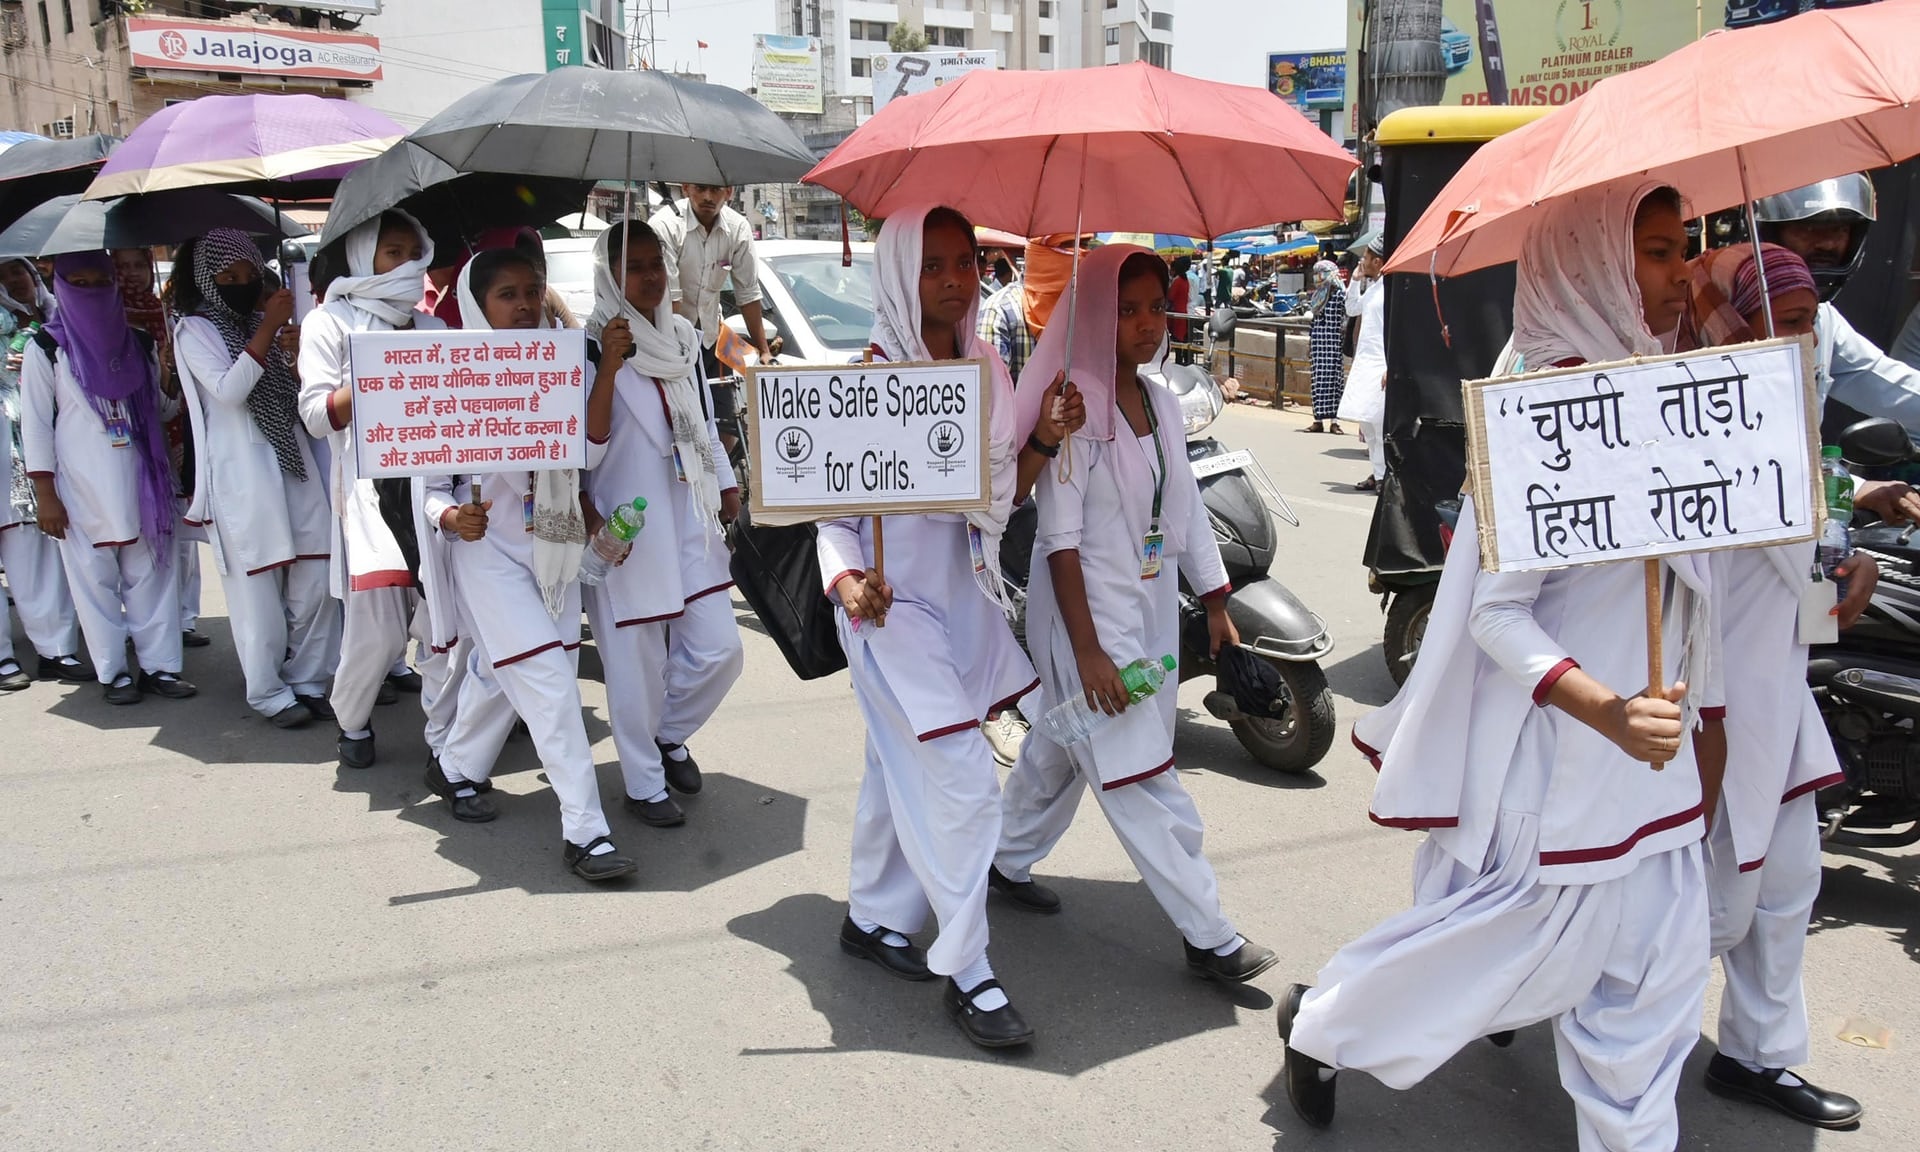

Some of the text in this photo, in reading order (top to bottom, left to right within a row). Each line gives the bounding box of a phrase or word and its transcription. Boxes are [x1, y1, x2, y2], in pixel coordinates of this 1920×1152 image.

[1581, 2, 1598, 31] 1st
[193, 37, 376, 66] Jalajoga AC Restaurant
[1569, 34, 1606, 51] ROYAL
[1541, 46, 1633, 69] PLATINUM DEALER
[1526, 73, 1542, 83] ONLY
[1543, 71, 1560, 81] CLUB
[1577, 66, 1603, 78] DEALER
[1604, 65, 1613, 74] OF
[1615, 62, 1628, 73] THE
[1461, 79, 1602, 106] PRMSON
[384, 341, 555, 365] भारत में, हर दो बच्चे में से
[358, 366, 582, 393] एक के साथ यौनिक शोषन हुआ है
[404, 391, 540, 416] हमें इसे पहचानना है
[761, 375, 965, 427] Make Safe Spaces
[1657, 355, 1764, 437] तोड़ो,
[365, 422, 394, 444] और
[398, 420, 436, 443] इसके
[441, 419, 465, 439] बारे
[469, 418, 485, 438] में
[525, 420, 563, 435] करना
[567, 415, 577, 435] है
[380, 447, 407, 468] और
[411, 444, 452, 465] अपनी
[456, 447, 502, 464] आवाज
[508, 440, 546, 461] उठानी
[825, 450, 914, 492] for Girls.
[1526, 483, 1620, 559] हिंसा
